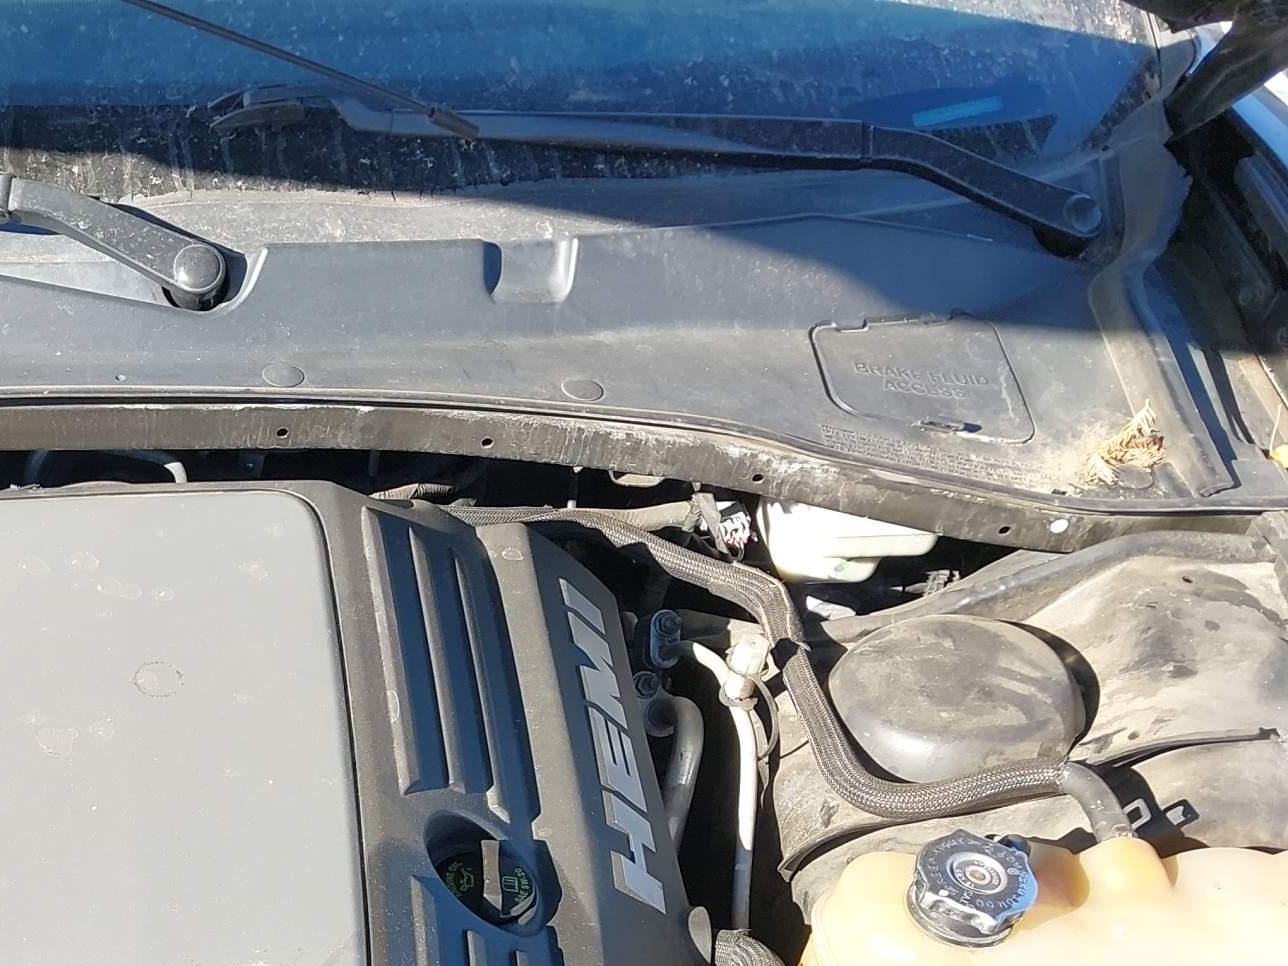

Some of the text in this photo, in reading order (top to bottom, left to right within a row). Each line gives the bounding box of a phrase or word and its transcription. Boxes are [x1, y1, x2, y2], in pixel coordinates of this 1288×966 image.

[852, 361, 990, 386] BRAKE FLUID
[883, 377, 967, 400] ACCESS
[559, 578, 666, 914] HEMI
